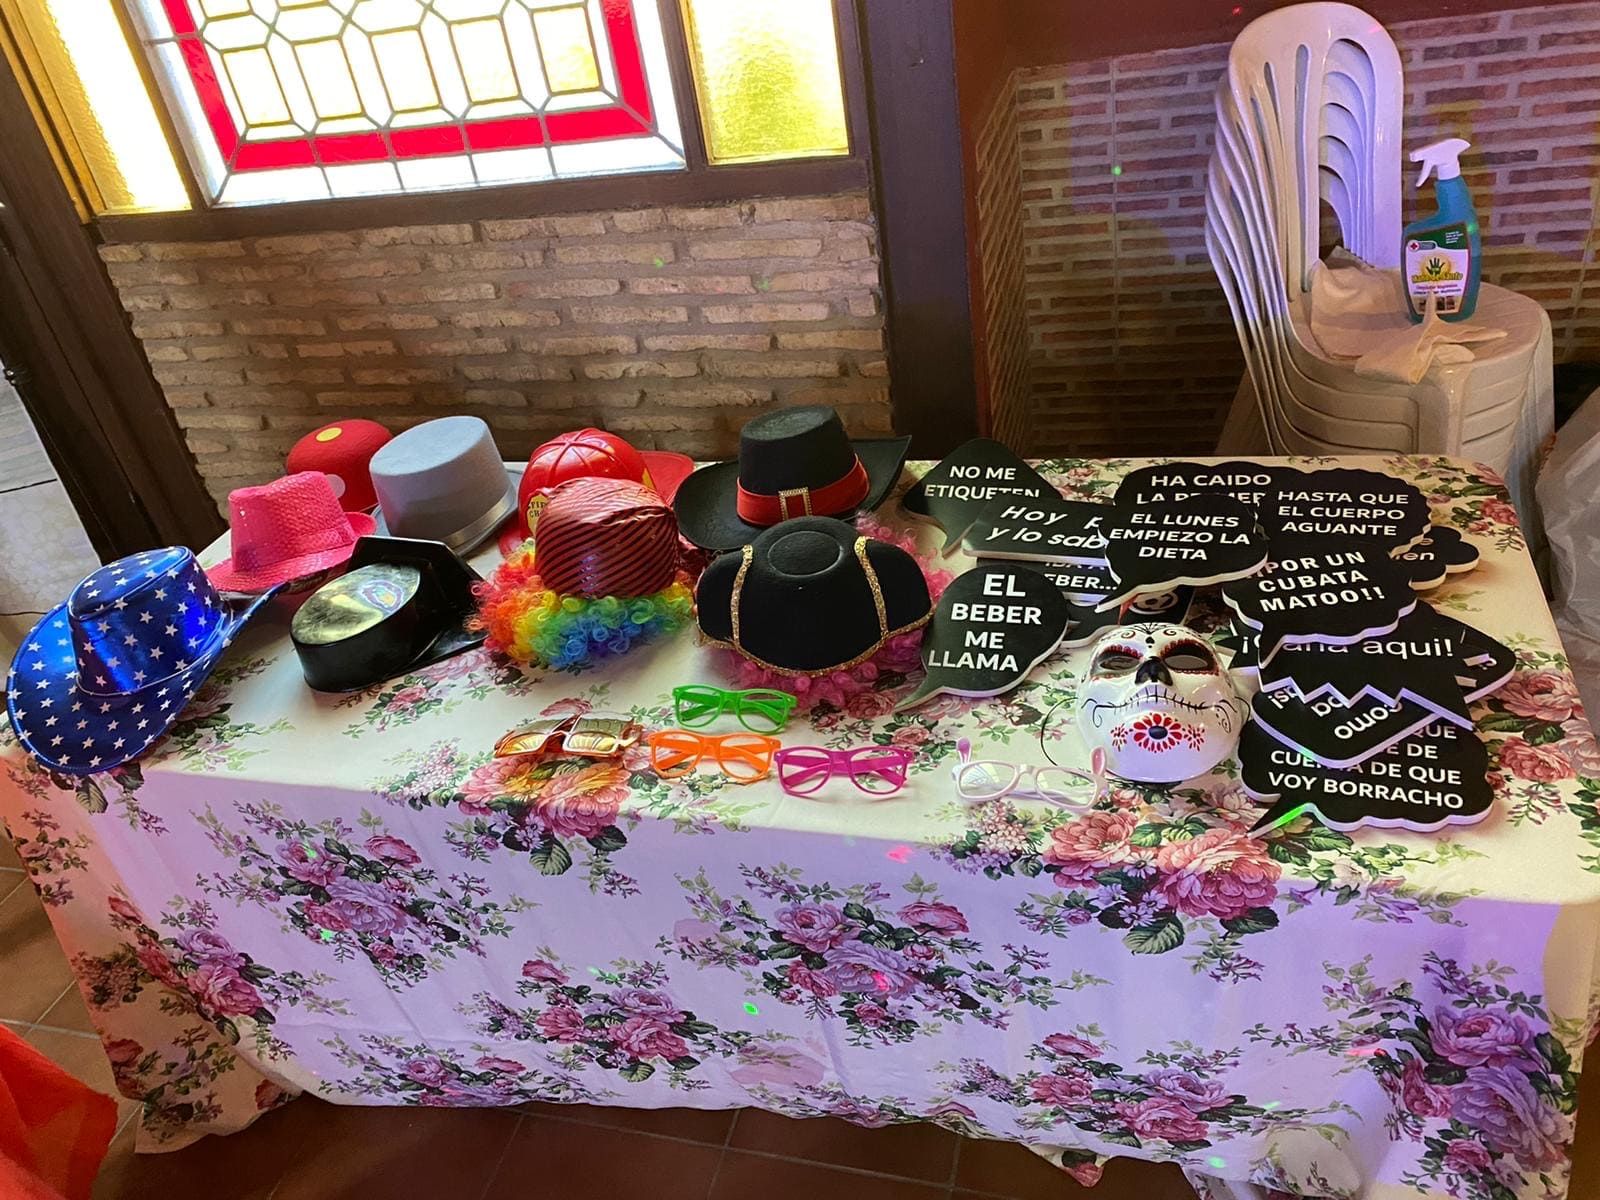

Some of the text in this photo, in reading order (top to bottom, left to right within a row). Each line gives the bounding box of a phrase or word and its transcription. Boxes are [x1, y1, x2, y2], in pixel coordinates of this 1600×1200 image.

[949, 465, 1017, 480] NO ME
[1151, 474, 1272, 487] HA CAIDO
[1136, 492, 1166, 505] LA
[1277, 491, 1409, 505] HASTA QUE
[1000, 505, 1067, 526] Hoy
[1130, 513, 1240, 528] EL LUNES
[1278, 506, 1405, 520] EL CUERPO
[985, 527, 1010, 541] y
[1012, 527, 1042, 542] lo
[1109, 528, 1251, 545] EMPIEZO LA
[1281, 521, 1398, 536] AGUANTE
[1138, 546, 1208, 561] DIETA
[1325, 551, 1366, 567] UN
[982, 574, 1026, 598] EL
[1258, 569, 1369, 593] CUBATA
[1259, 586, 1386, 613] MATOO!!
[950, 603, 1043, 625] BEBER
[964, 631, 1005, 649] ME
[927, 650, 1019, 672] LLAMA
[1406, 743, 1439, 759] DE
[1370, 761, 1402, 778] DE
[1408, 766, 1462, 785] QUE
[1268, 771, 1464, 809] VOY BORRACHO
